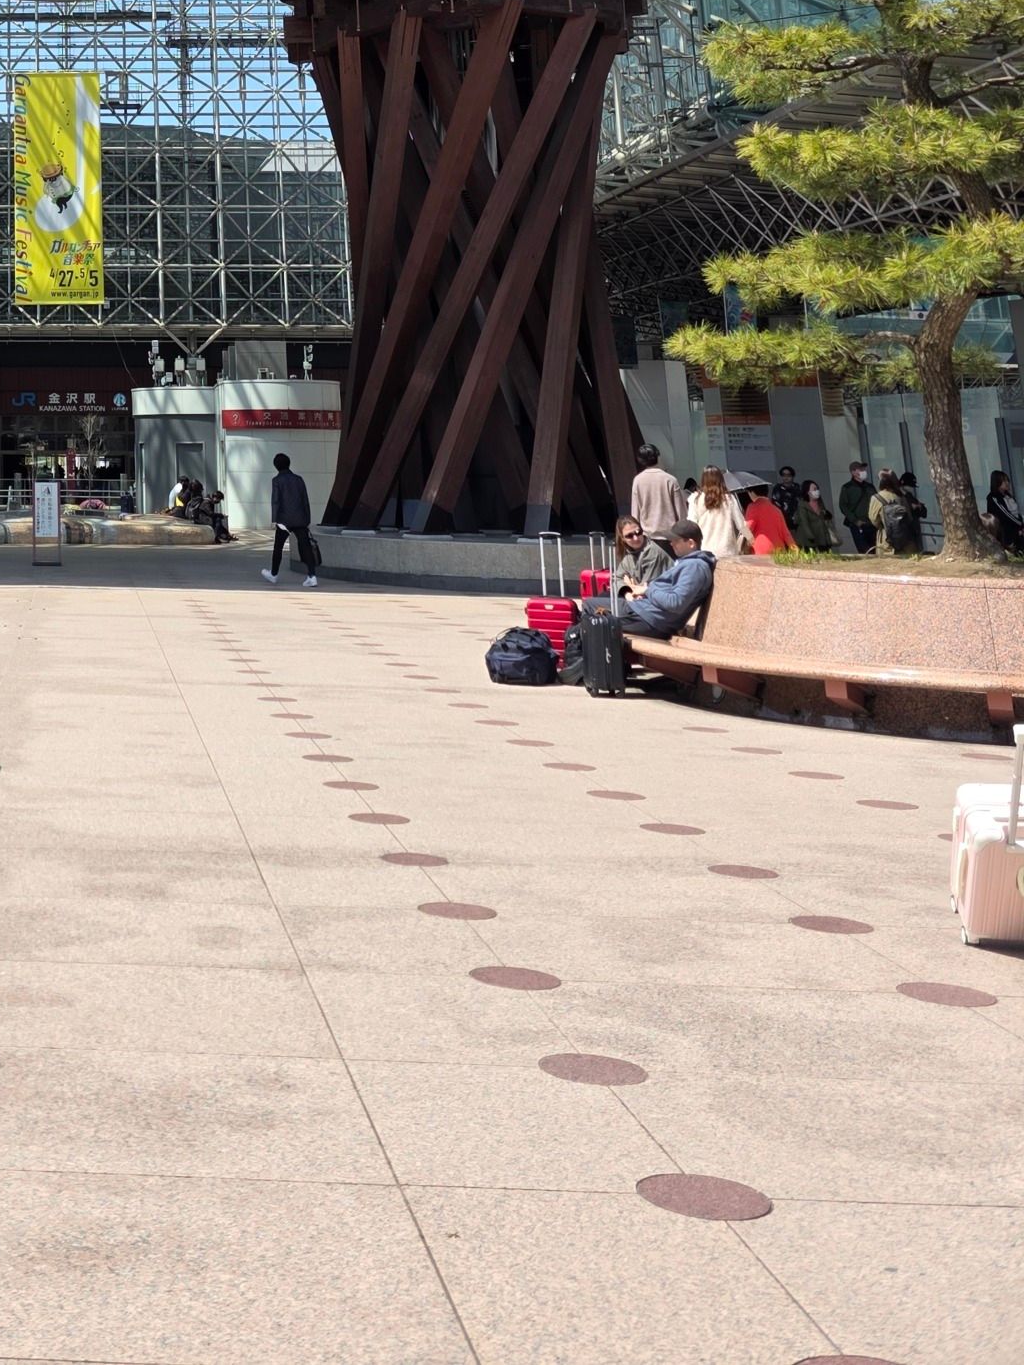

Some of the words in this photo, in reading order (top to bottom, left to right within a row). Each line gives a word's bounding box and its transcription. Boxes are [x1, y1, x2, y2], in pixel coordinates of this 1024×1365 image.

[15, 73, 32, 165] Gargantua
[15, 170, 32, 223] Music
[15, 228, 33, 303] Festival
[63, 251, 95, 266] 音楽祭
[51, 290, 99, 299] www.gargan.jp
[12, 392, 36, 407] JR
[48, 392, 96, 404] 金沢駅
